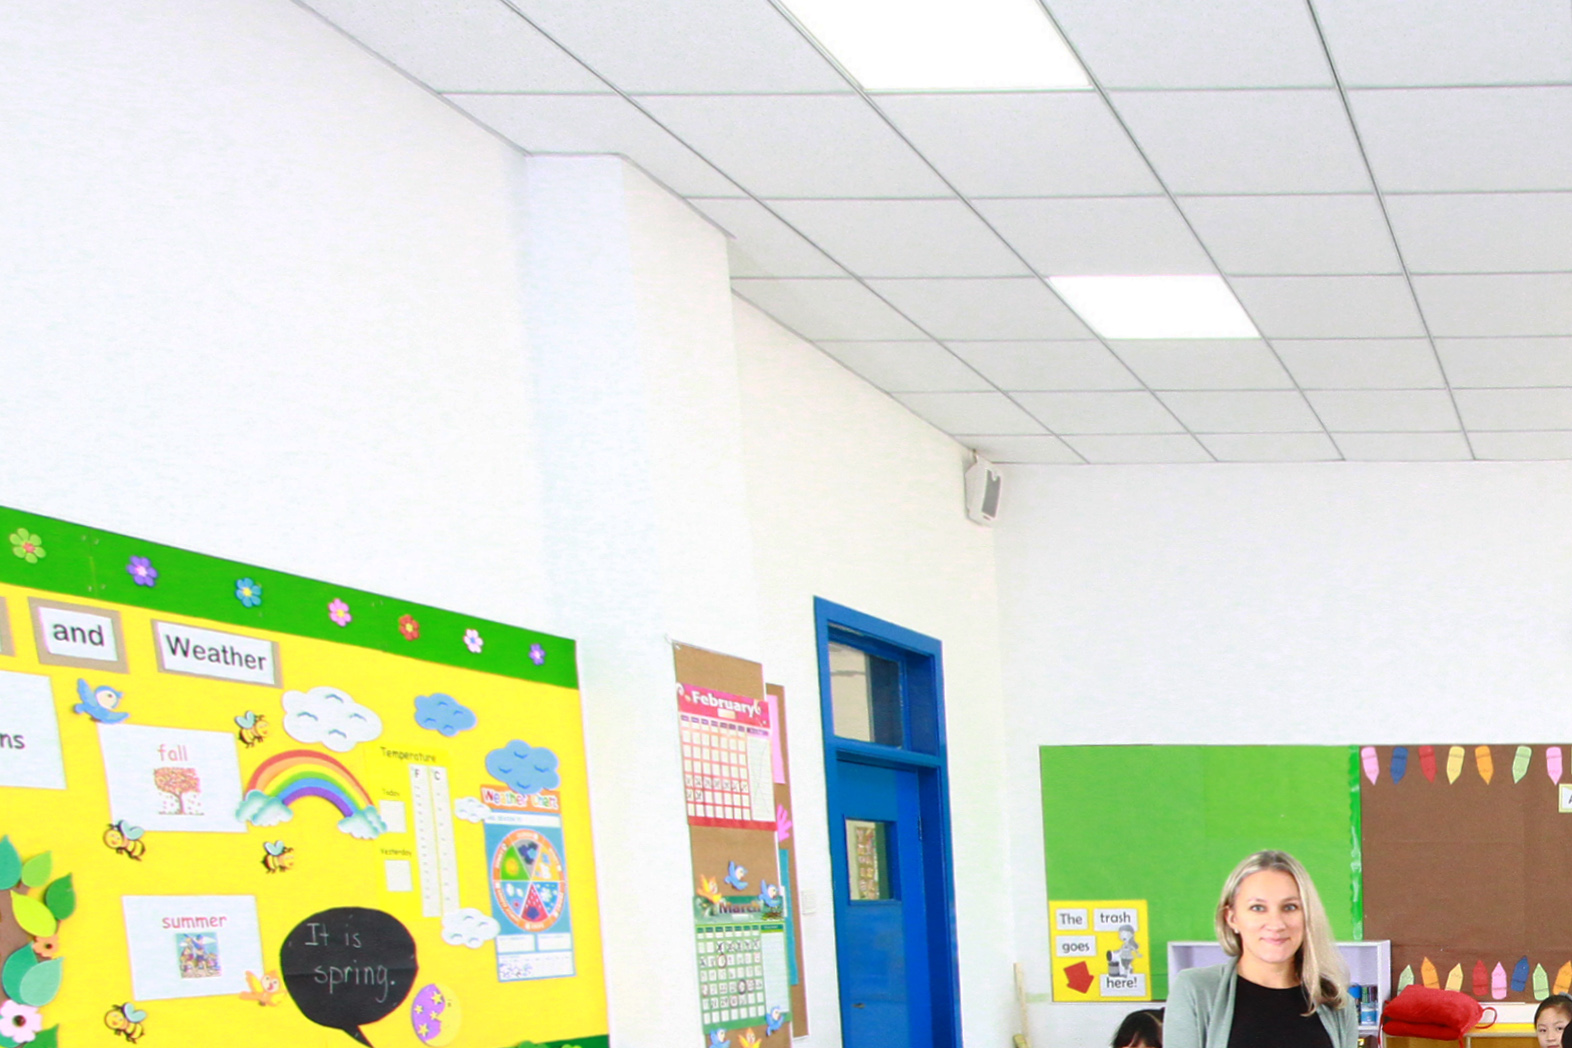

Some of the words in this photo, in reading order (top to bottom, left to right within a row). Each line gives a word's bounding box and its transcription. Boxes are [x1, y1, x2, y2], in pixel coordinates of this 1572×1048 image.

[53, 623, 104, 647] and
[165, 634, 267, 670] Weather
[691, 691, 756, 717] February
[158, 743, 188, 762] fall
[380, 746, 437, 763] Temperature
[719, 901, 762, 914] March
[162, 915, 227, 930] summer
[1060, 913, 1083, 925] The
[1100, 911, 1131, 923] trash
[304, 922, 329, 946] It
[345, 924, 362, 948] is
[1062, 942, 1090, 954] goes
[314, 959, 396, 1004] spring.
[1106, 976, 1137, 988] here!
